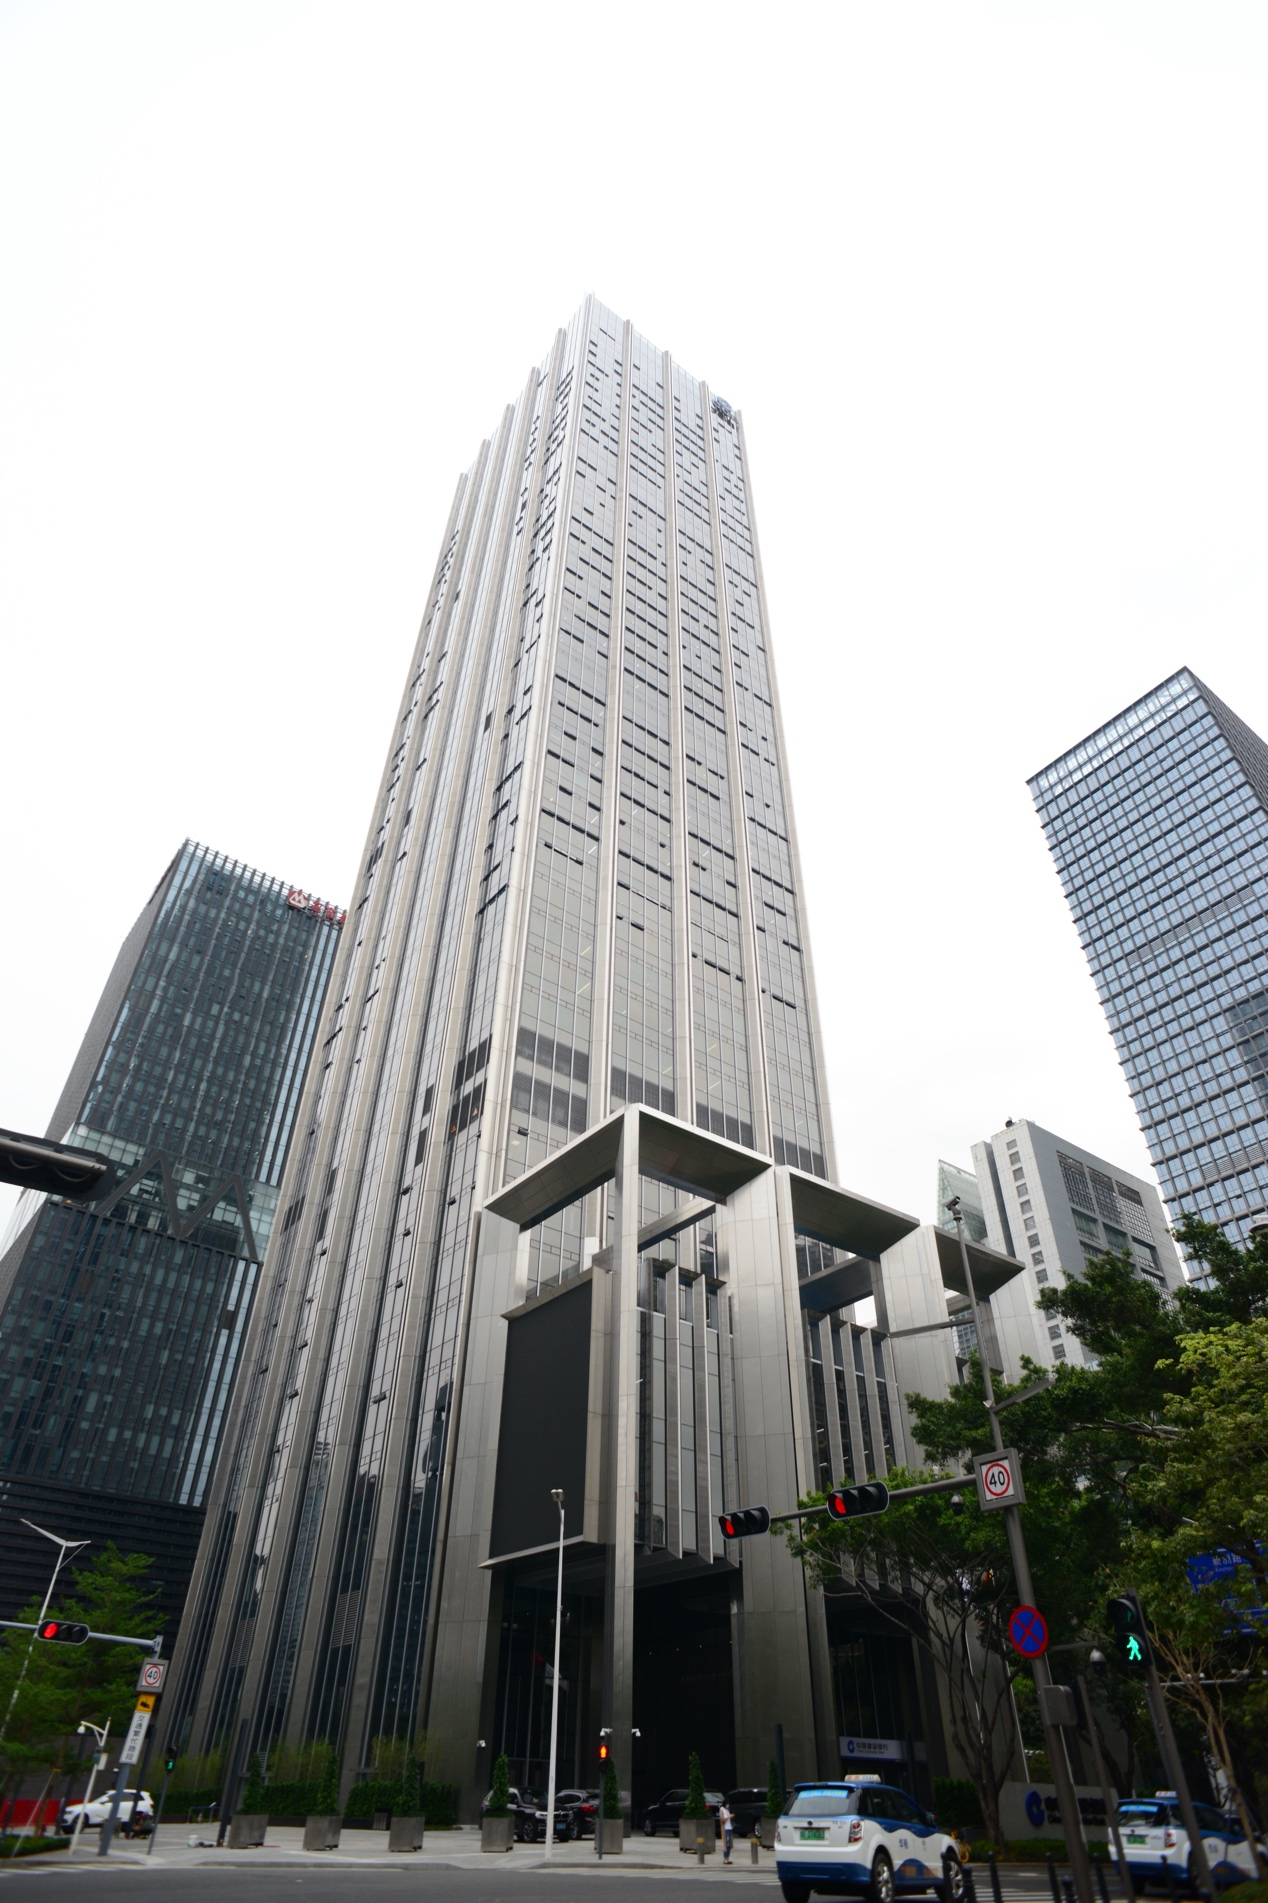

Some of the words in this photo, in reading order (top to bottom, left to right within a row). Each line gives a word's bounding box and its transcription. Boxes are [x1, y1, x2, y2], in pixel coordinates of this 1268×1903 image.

[989, 1470, 1006, 1488] 40
[147, 1670, 158, 1680] 40
[125, 1714, 145, 1761] 交通繁忙路段
